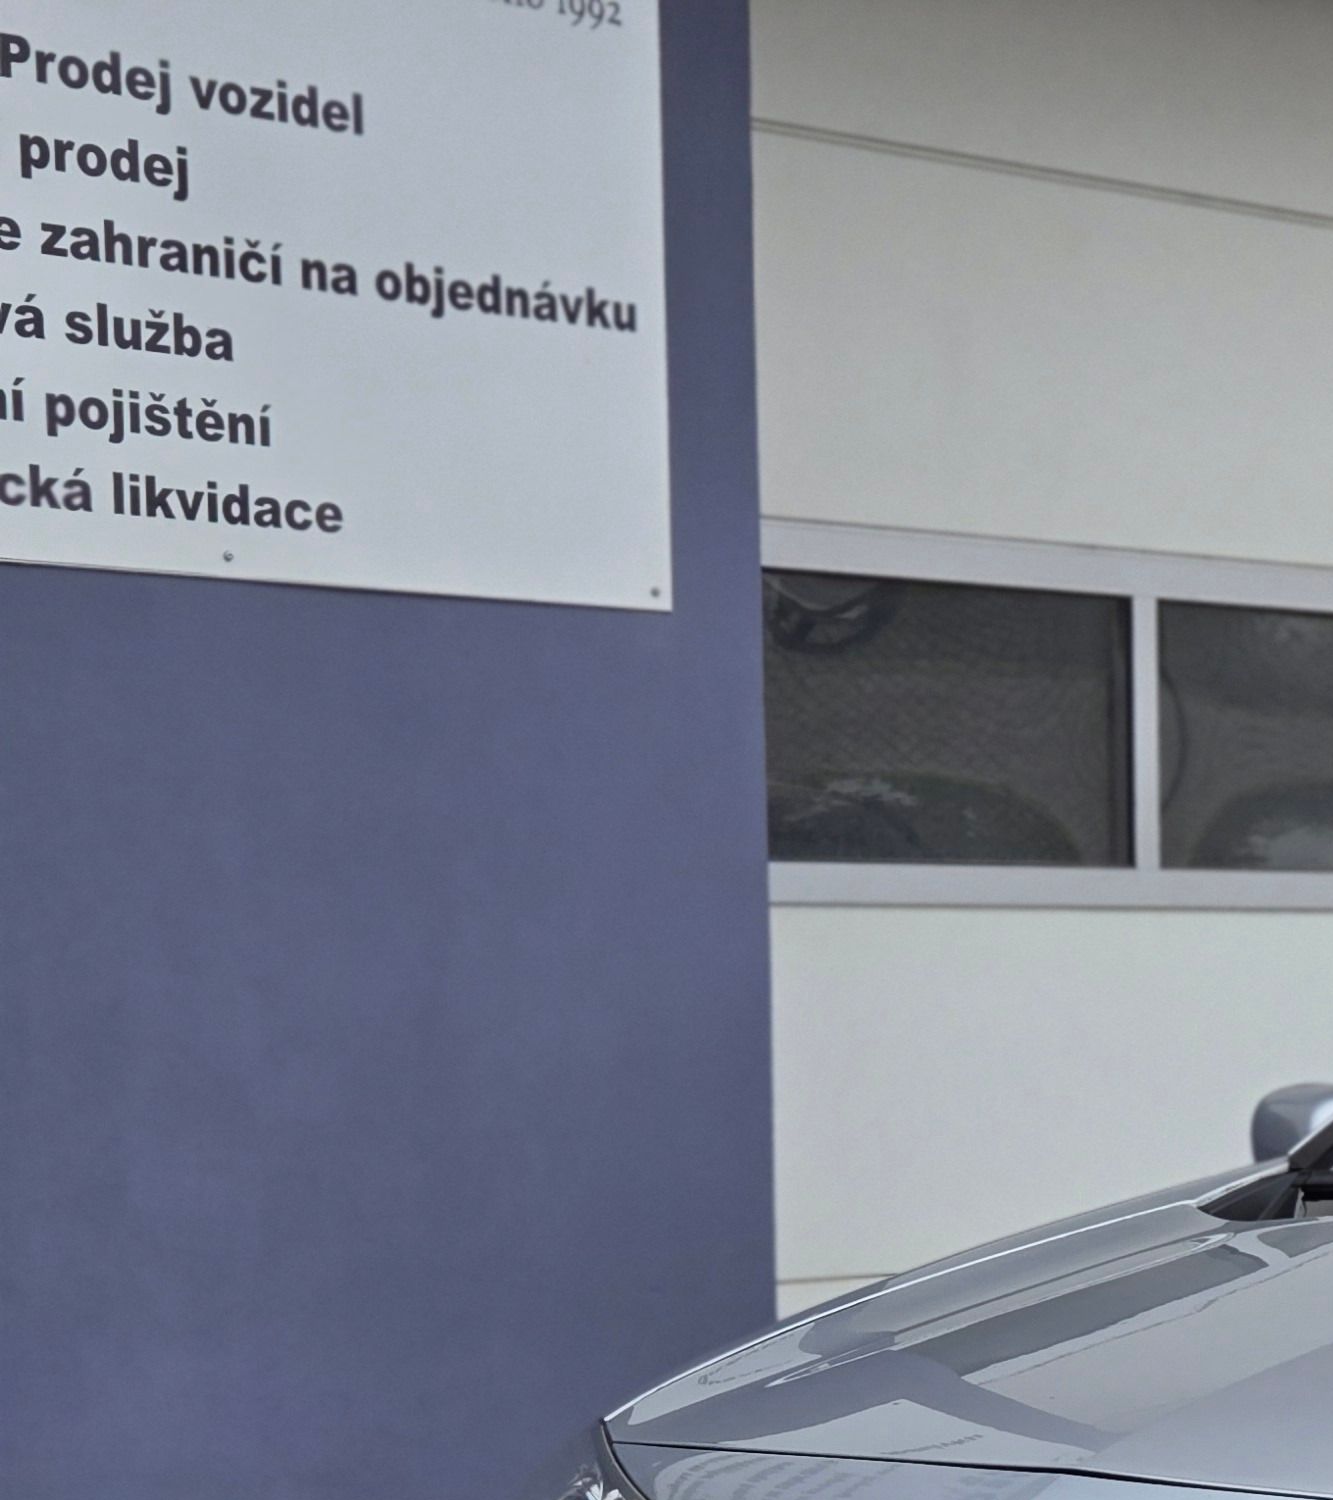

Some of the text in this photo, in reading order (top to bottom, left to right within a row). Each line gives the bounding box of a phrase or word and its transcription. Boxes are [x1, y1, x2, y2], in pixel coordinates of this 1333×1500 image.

[0, 33, 364, 135] Prodej vozidel
[20, 133, 189, 201] prodej
[40, 219, 283, 286] zahraničí
[301, 258, 359, 296] na
[375, 262, 637, 333] objednávku
[65, 303, 234, 361] služba
[46, 388, 271, 447] pojištění
[113, 472, 344, 533] likvidace
